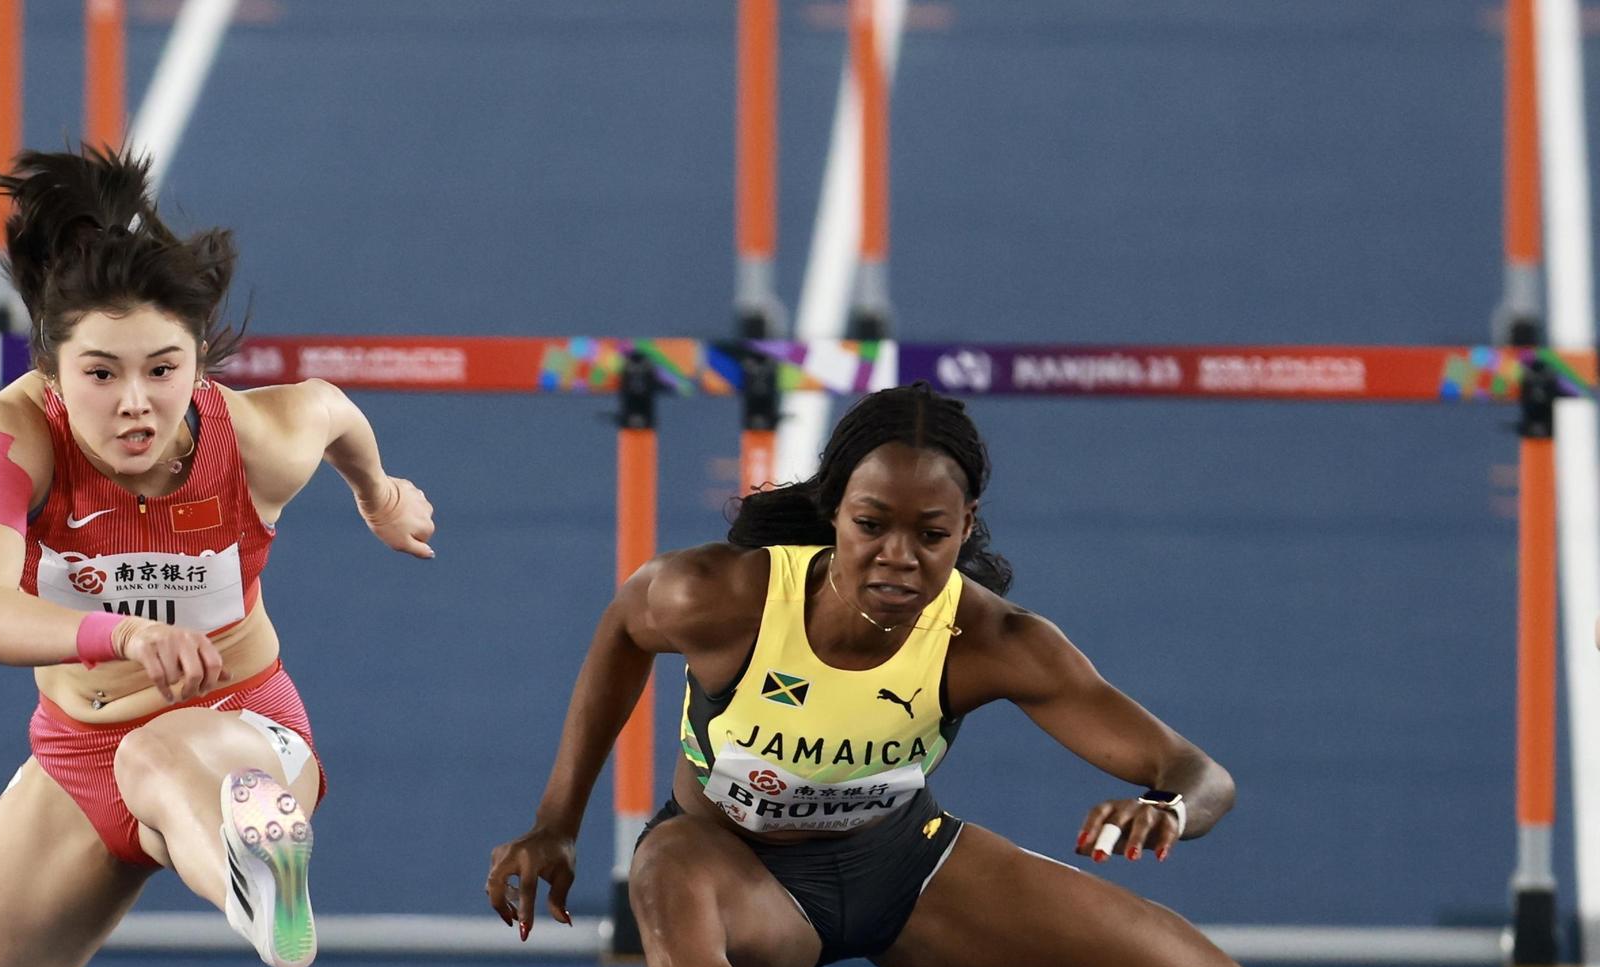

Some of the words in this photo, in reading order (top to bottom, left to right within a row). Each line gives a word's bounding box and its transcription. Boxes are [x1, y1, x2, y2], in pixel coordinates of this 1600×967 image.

[116, 583, 144, 592] BANK
[164, 583, 208, 592] NANJING
[736, 725, 928, 766] JAMAICA
[728, 782, 897, 819] BROWN
